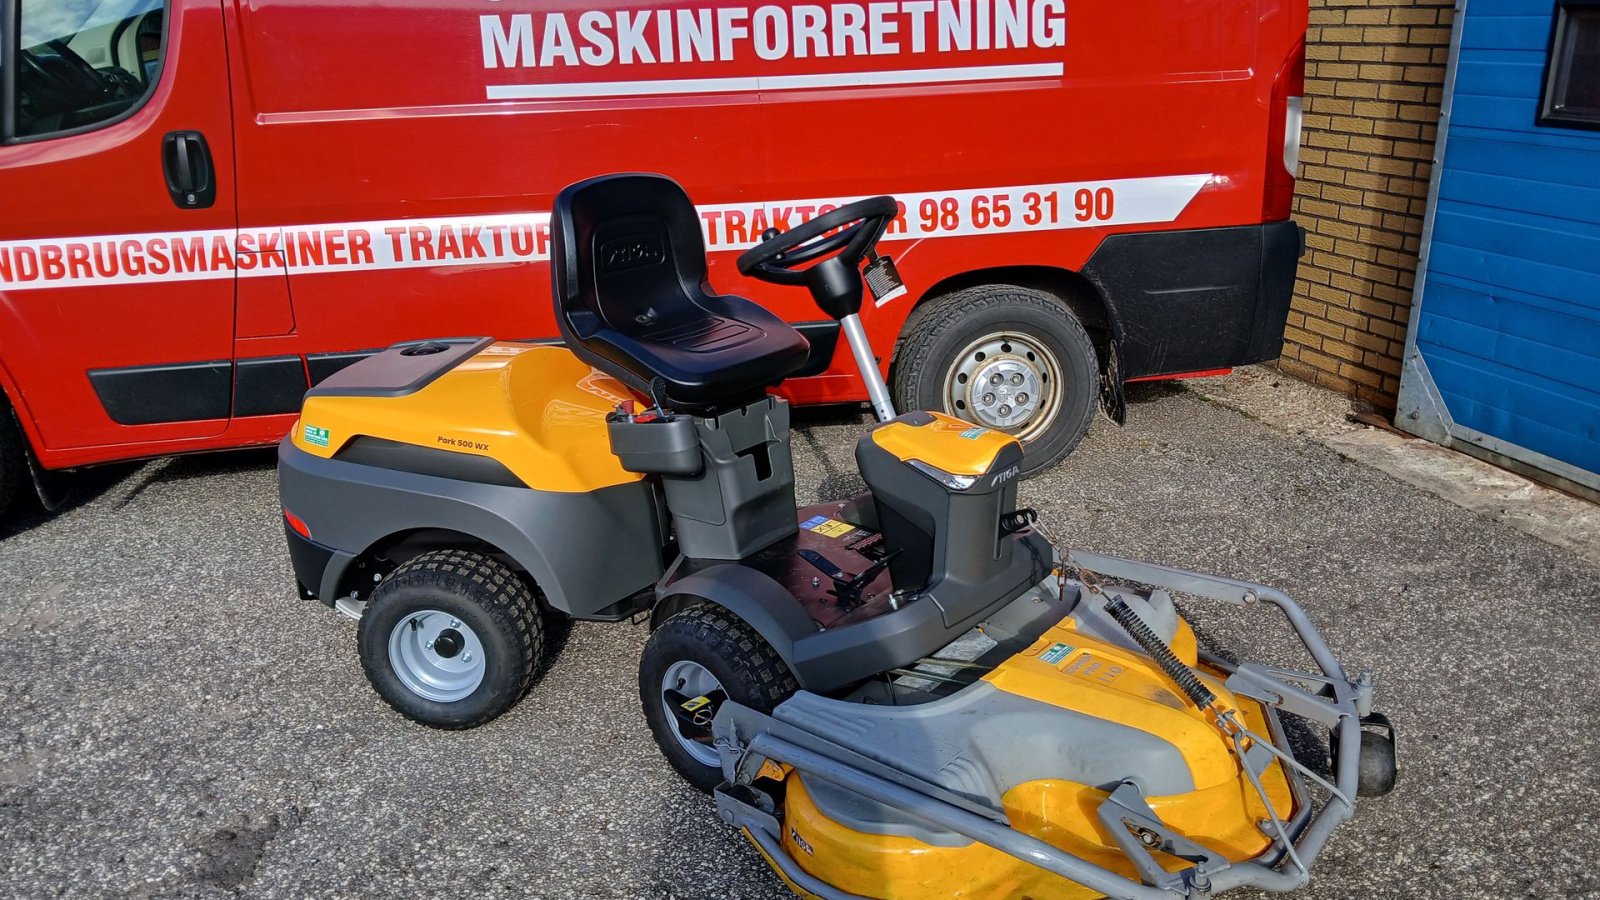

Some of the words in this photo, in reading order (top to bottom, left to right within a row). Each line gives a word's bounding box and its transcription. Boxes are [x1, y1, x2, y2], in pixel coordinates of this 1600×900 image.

[479, 0, 1066, 69] MASKINFORRETNING
[919, 198, 959, 233] 98
[971, 194, 1012, 229] 65
[1022, 191, 1058, 226] 31
[1074, 187, 1115, 222] 90
[437, 435, 457, 446] Park
[457, 439, 474, 449] 500
[474, 442, 490, 451] WX
